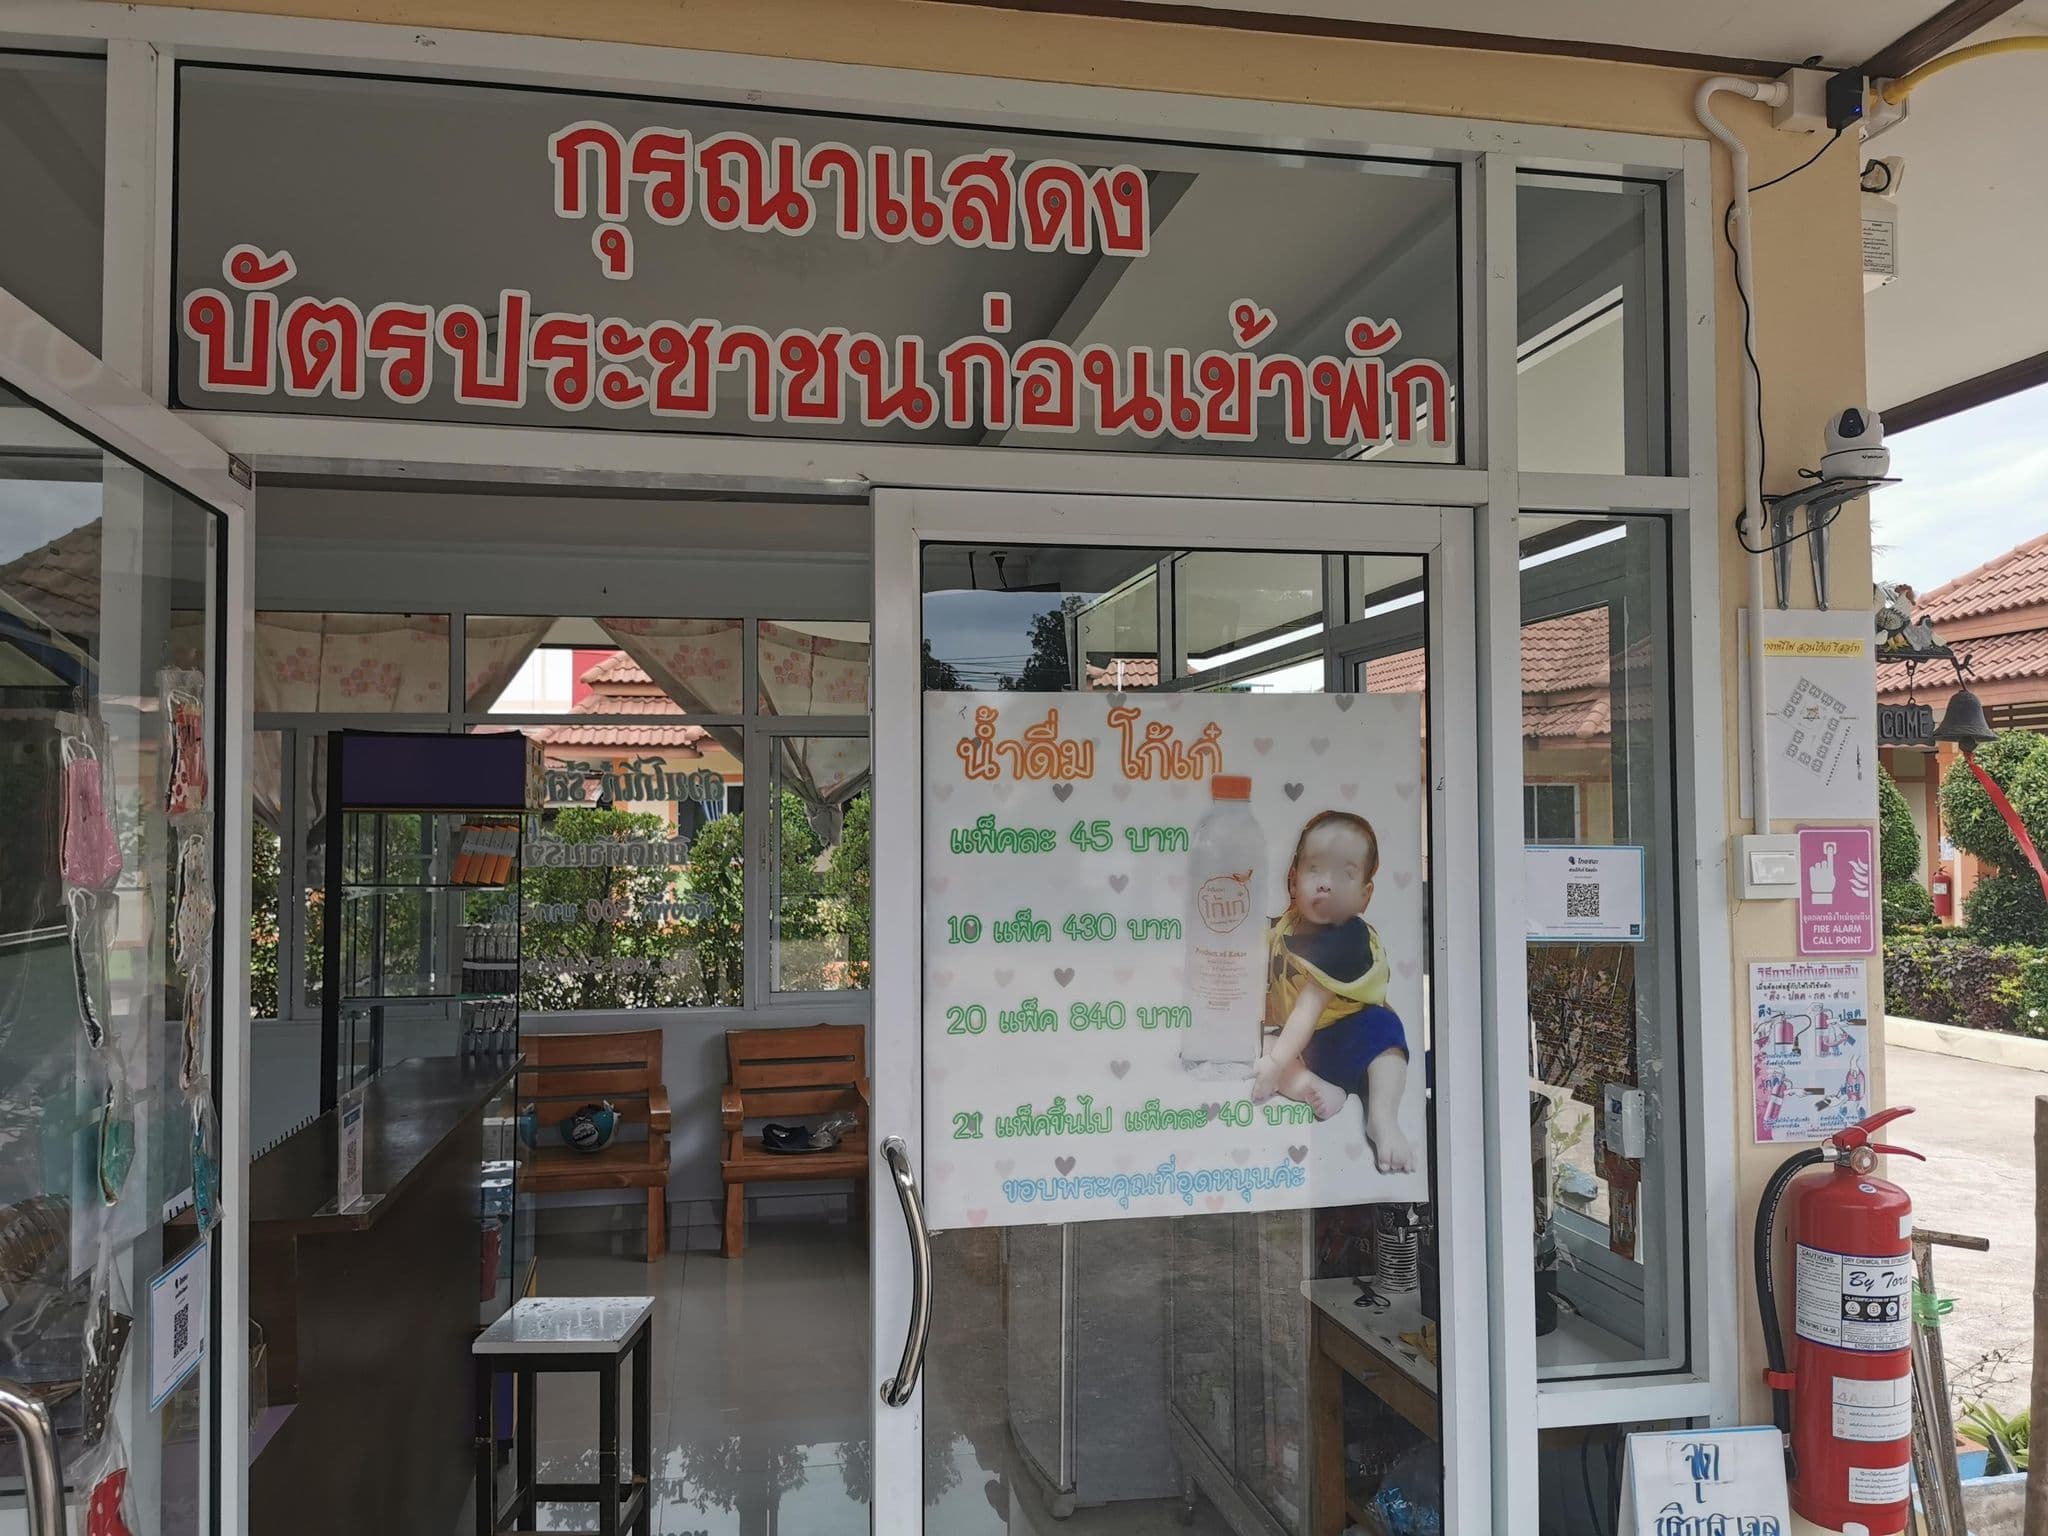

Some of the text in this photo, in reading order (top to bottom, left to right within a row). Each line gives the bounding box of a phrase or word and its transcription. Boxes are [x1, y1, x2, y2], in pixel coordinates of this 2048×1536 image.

[183, 243, 1452, 449] บัตรประชาชนก่อนเข้าพัก
[1880, 710, 1930, 739] COME
[957, 705, 1224, 782] น้ำดื่ม โก้เก๋
[949, 815, 1190, 854] แพ็คละ 45 บาท
[947, 908, 1182, 945] 10 แพ็ค 430 บาท
[1813, 925, 1862, 934] FIRE ALARM
[1813, 936, 1862, 945] CALL POINT
[946, 998, 1192, 1035] 20 แพ็ค 840 บาท
[952, 1095, 1315, 1141] 21 แพ็คขึ้นไป แพ็คละ 40 บาท
[1800, 1249, 1835, 1264] CAUTIONS
[1849, 1271, 1876, 1292] By
